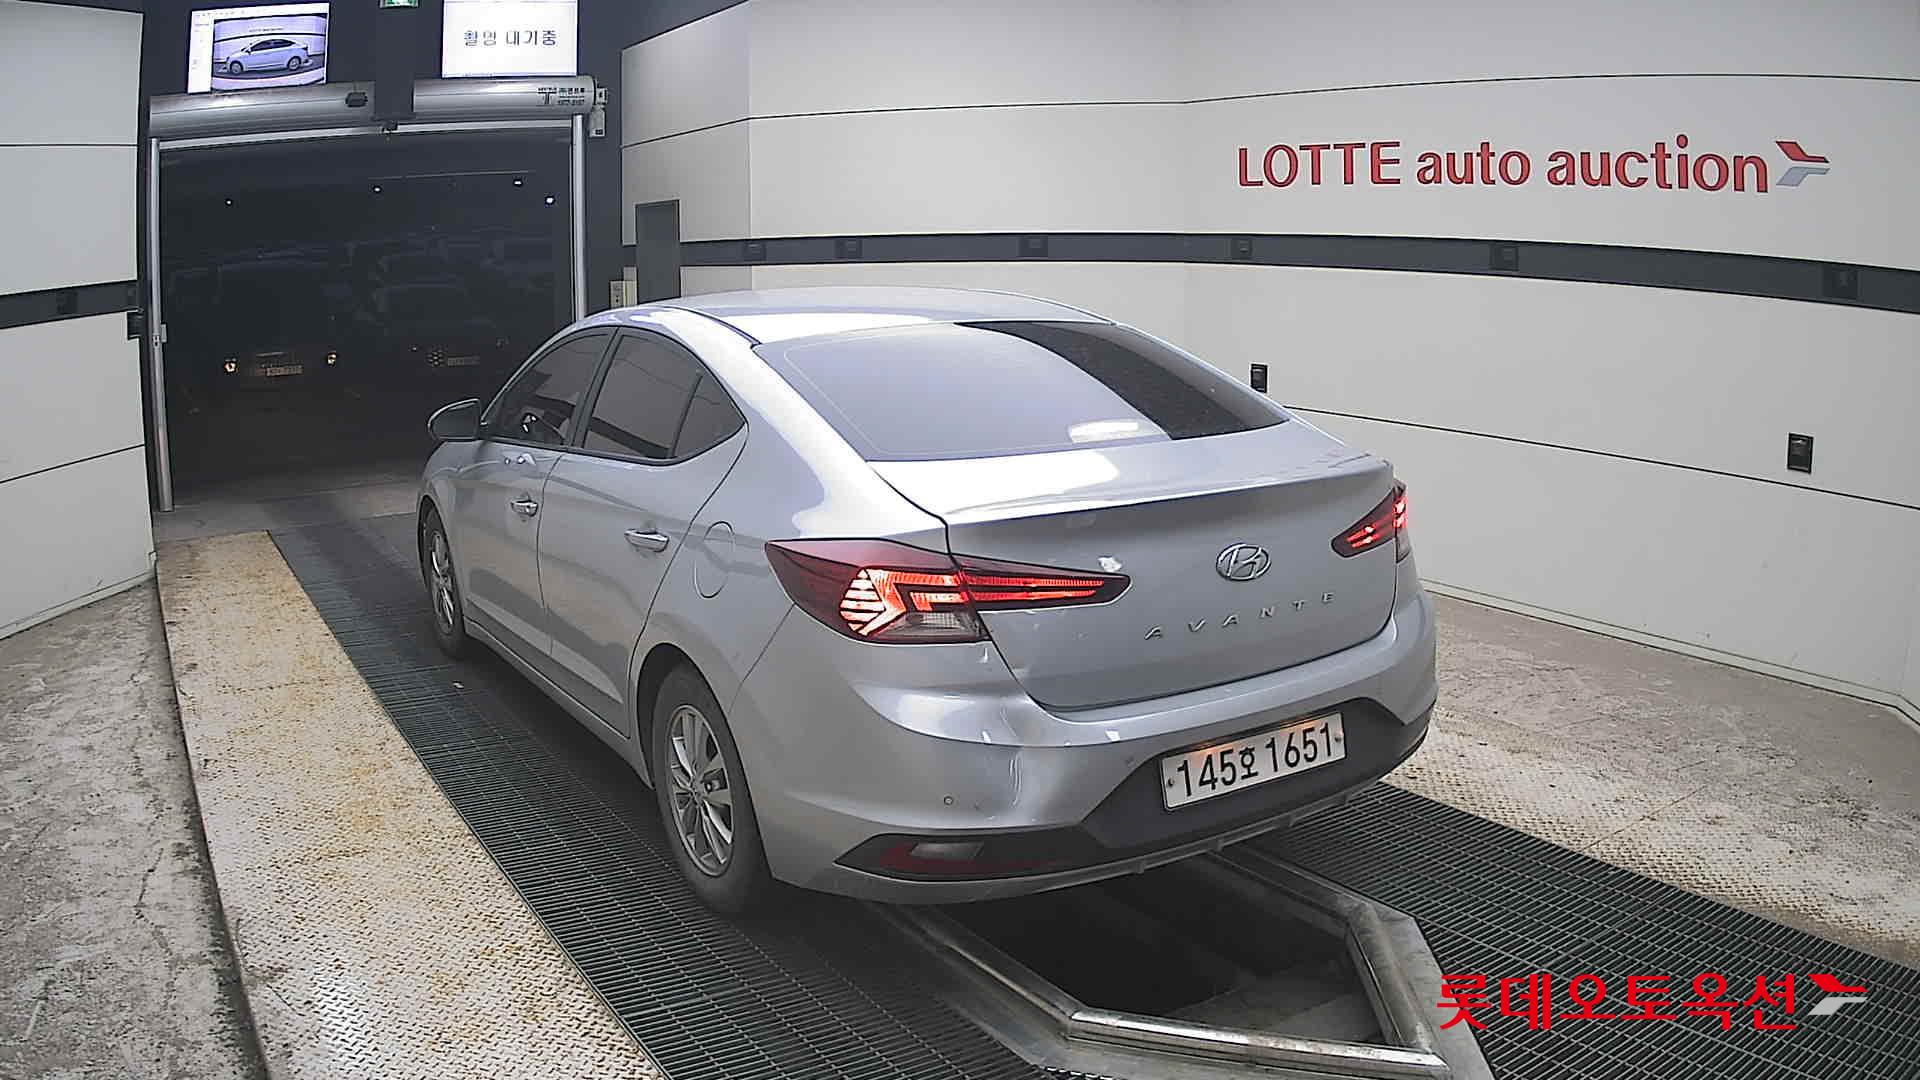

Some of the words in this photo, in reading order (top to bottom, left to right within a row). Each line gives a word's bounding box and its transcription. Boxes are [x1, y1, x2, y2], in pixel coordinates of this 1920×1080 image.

[1238, 140, 1401, 187] LOTTE
[1416, 143, 1531, 187] auto
[1546, 133, 1769, 194] auction
[1143, 591, 1336, 641] AVANTE
[1176, 746, 1259, 797] 145호
[1265, 721, 1333, 773] 1651
